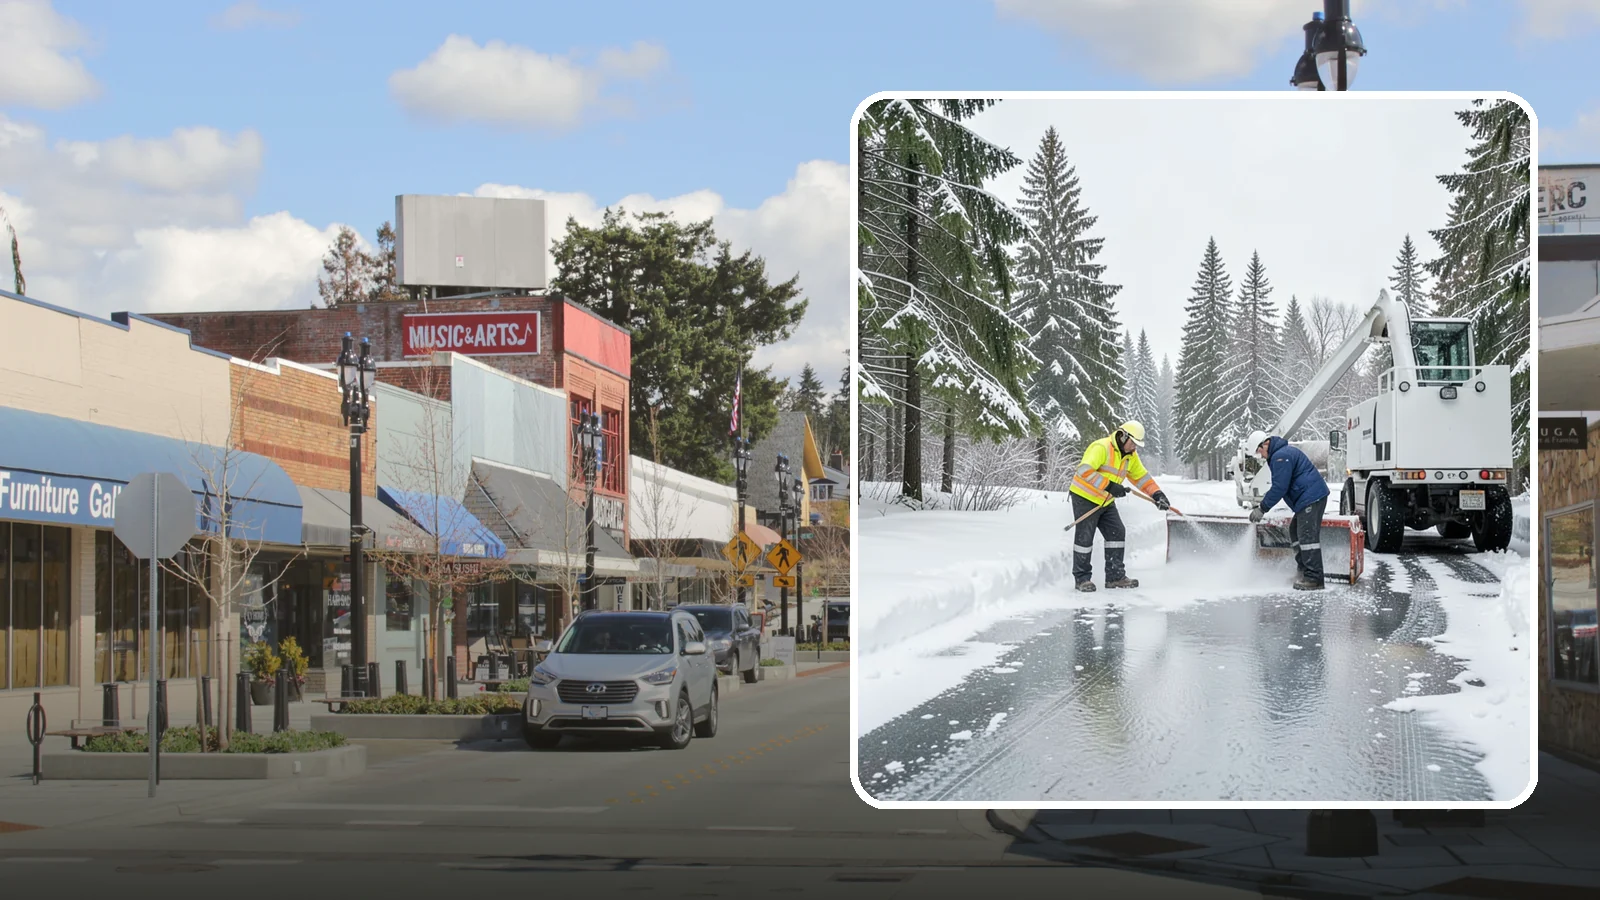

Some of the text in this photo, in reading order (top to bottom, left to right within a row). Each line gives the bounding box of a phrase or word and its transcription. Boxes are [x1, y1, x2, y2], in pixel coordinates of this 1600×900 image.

[1540, 427, 1577, 436] UGA
[0, 471, 122, 519] Furniture Gal
[453, 563, 479, 574] SUSHI
